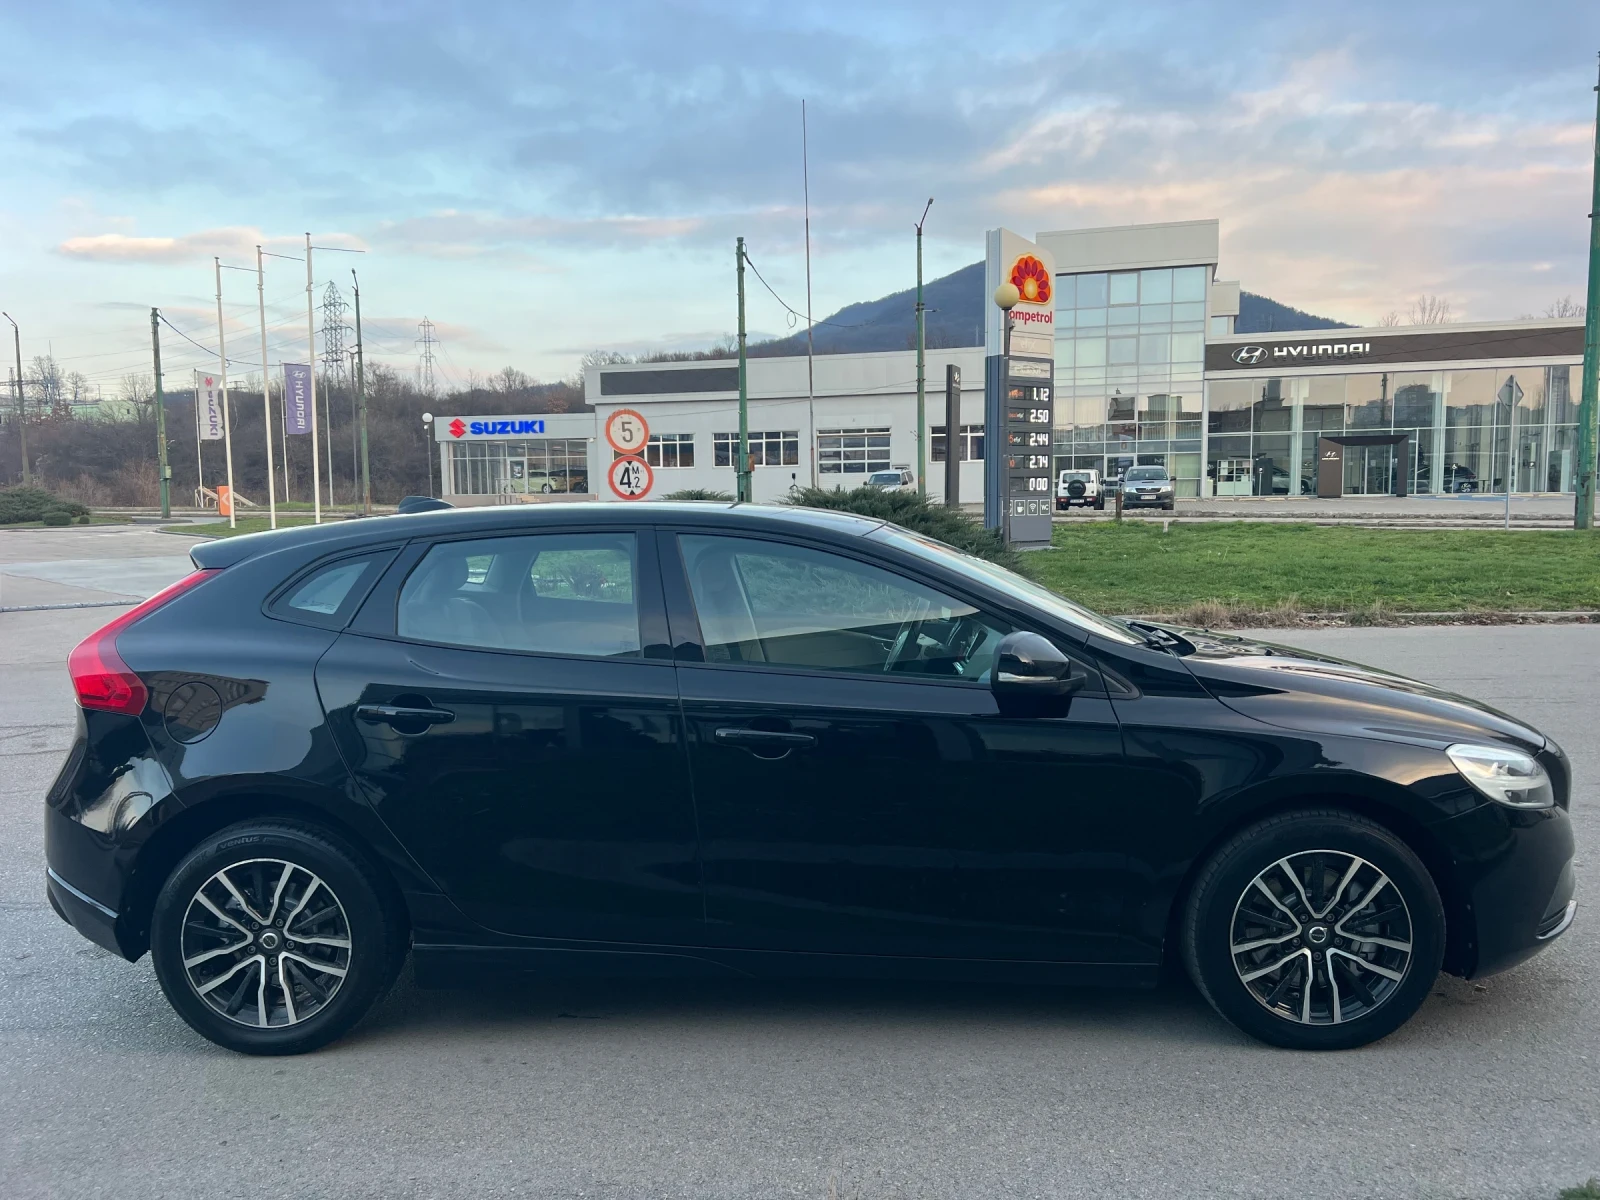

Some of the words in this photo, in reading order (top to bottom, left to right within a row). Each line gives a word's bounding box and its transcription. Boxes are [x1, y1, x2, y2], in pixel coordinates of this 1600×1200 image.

[1009, 311, 1052, 325] ompetrol
[1274, 343, 1370, 360] HYUNDAI
[1033, 387, 1049, 401] 1.12
[295, 381, 305, 429] HYUNDAI
[1030, 409, 1049, 422] 2.50
[470, 420, 545, 435] SUZUKI
[621, 421, 633, 443] 5
[1030, 433, 1049, 446] 2.44
[1030, 455, 1048, 468] 2.74
